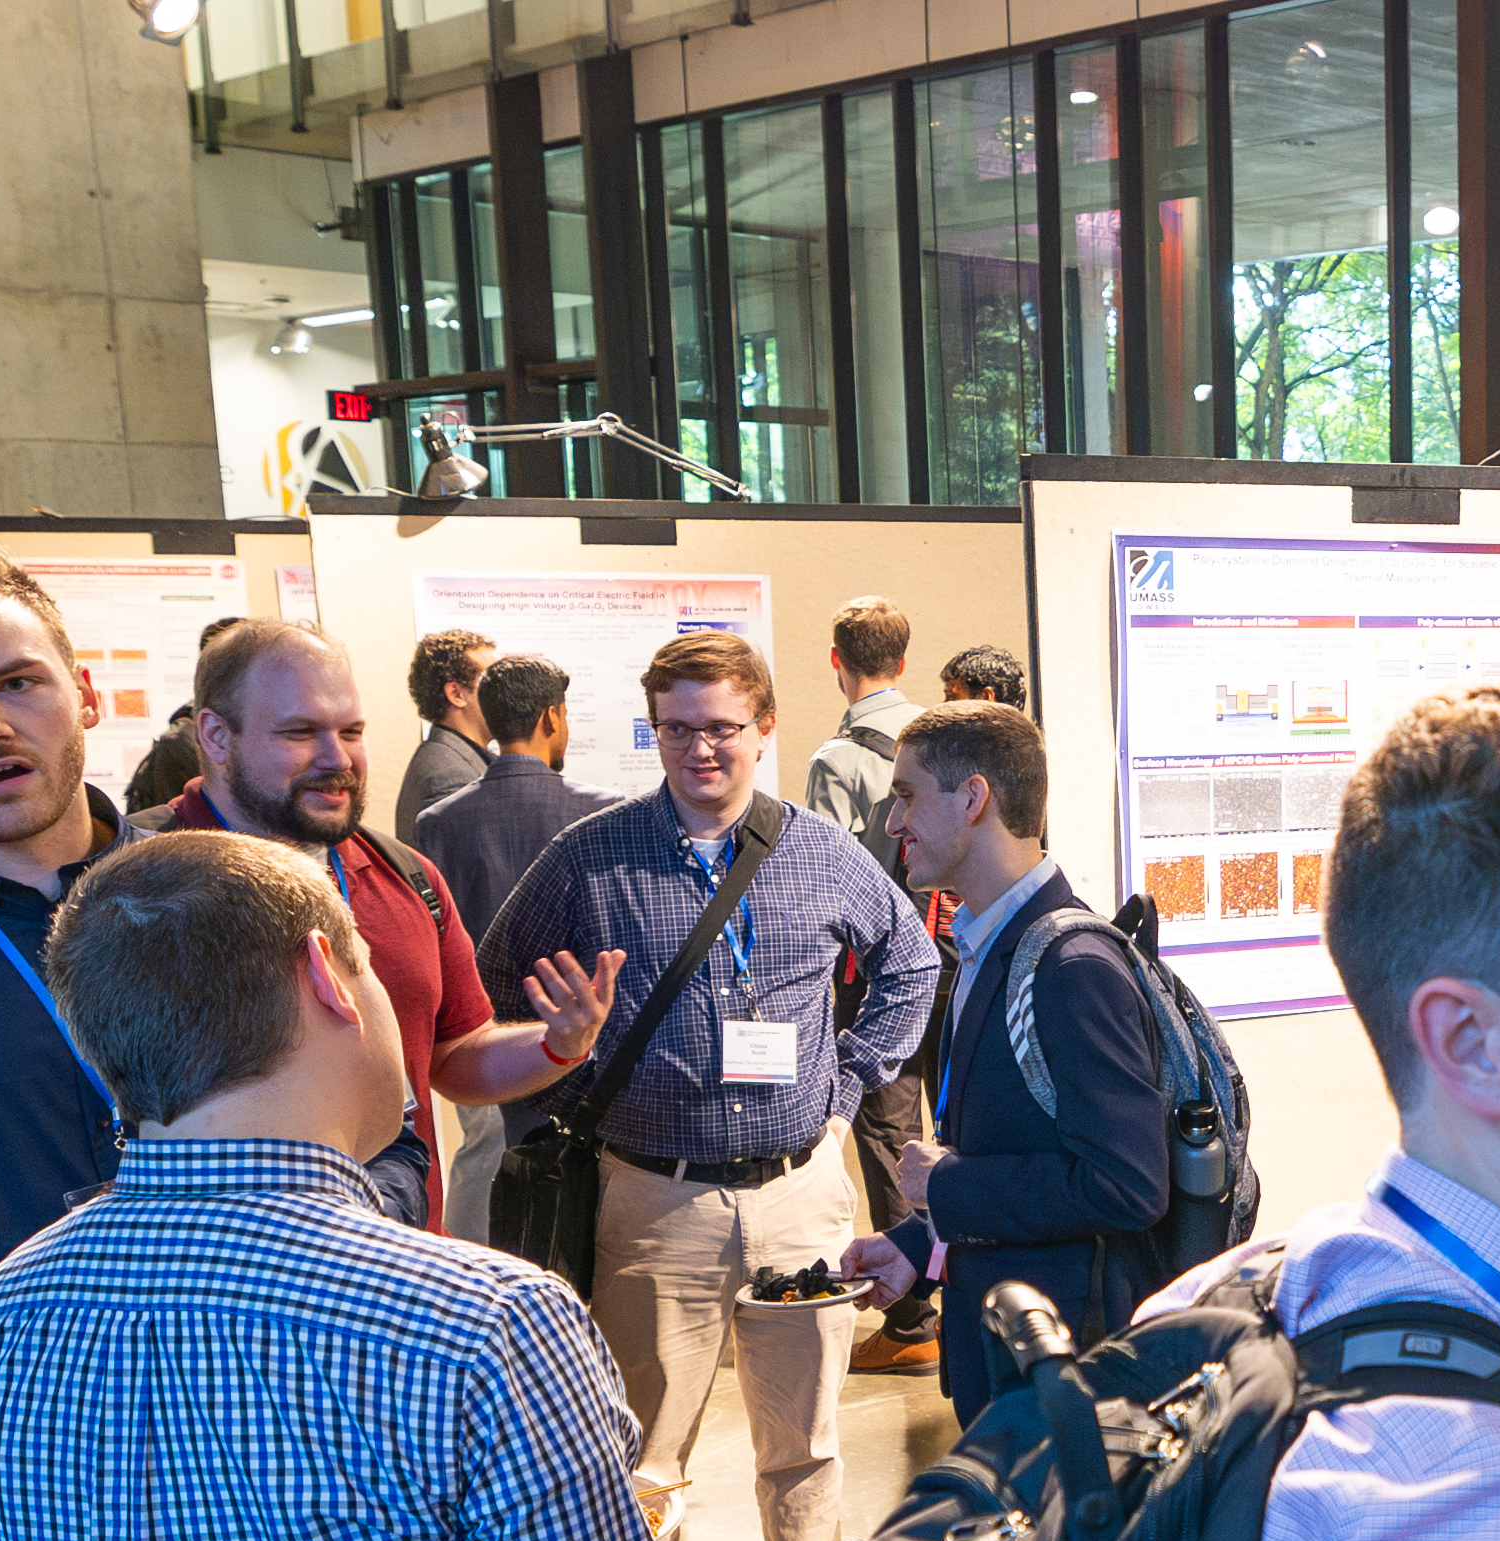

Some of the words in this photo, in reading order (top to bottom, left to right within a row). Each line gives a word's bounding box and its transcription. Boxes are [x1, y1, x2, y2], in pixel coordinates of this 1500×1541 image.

[334, 392, 367, 421] EXIT
[1192, 552, 1270, 568] Polycrystalline
[1272, 555, 1319, 566] Diamond
[1321, 556, 1358, 567] Growth
[1361, 559, 1372, 567] on
[1443, 558, 1456, 569] for
[1458, 559, 1498, 570] Scalable
[1345, 573, 1383, 584] Thermal
[1385, 574, 1447, 586] Management
[433, 589, 485, 599] Orientation
[488, 590, 545, 600] Dependence
[562, 591, 594, 599] Critical
[597, 590, 630, 600] Electric
[632, 591, 655, 600] Field
[656, 592, 665, 600] in
[1130, 592, 1174, 602] UMASS
[459, 601, 506, 611] Designing
[509, 602, 530, 611] High
[533, 602, 566, 612] Voltage
[607, 602, 642, 611] Devices
[1192, 616, 1241, 627] Introduction
[1242, 617, 1257, 627] and
[1133, 757, 1165, 768] Surface
[1166, 756, 1213, 768] Morphology
[1215, 756, 1224, 765] of
